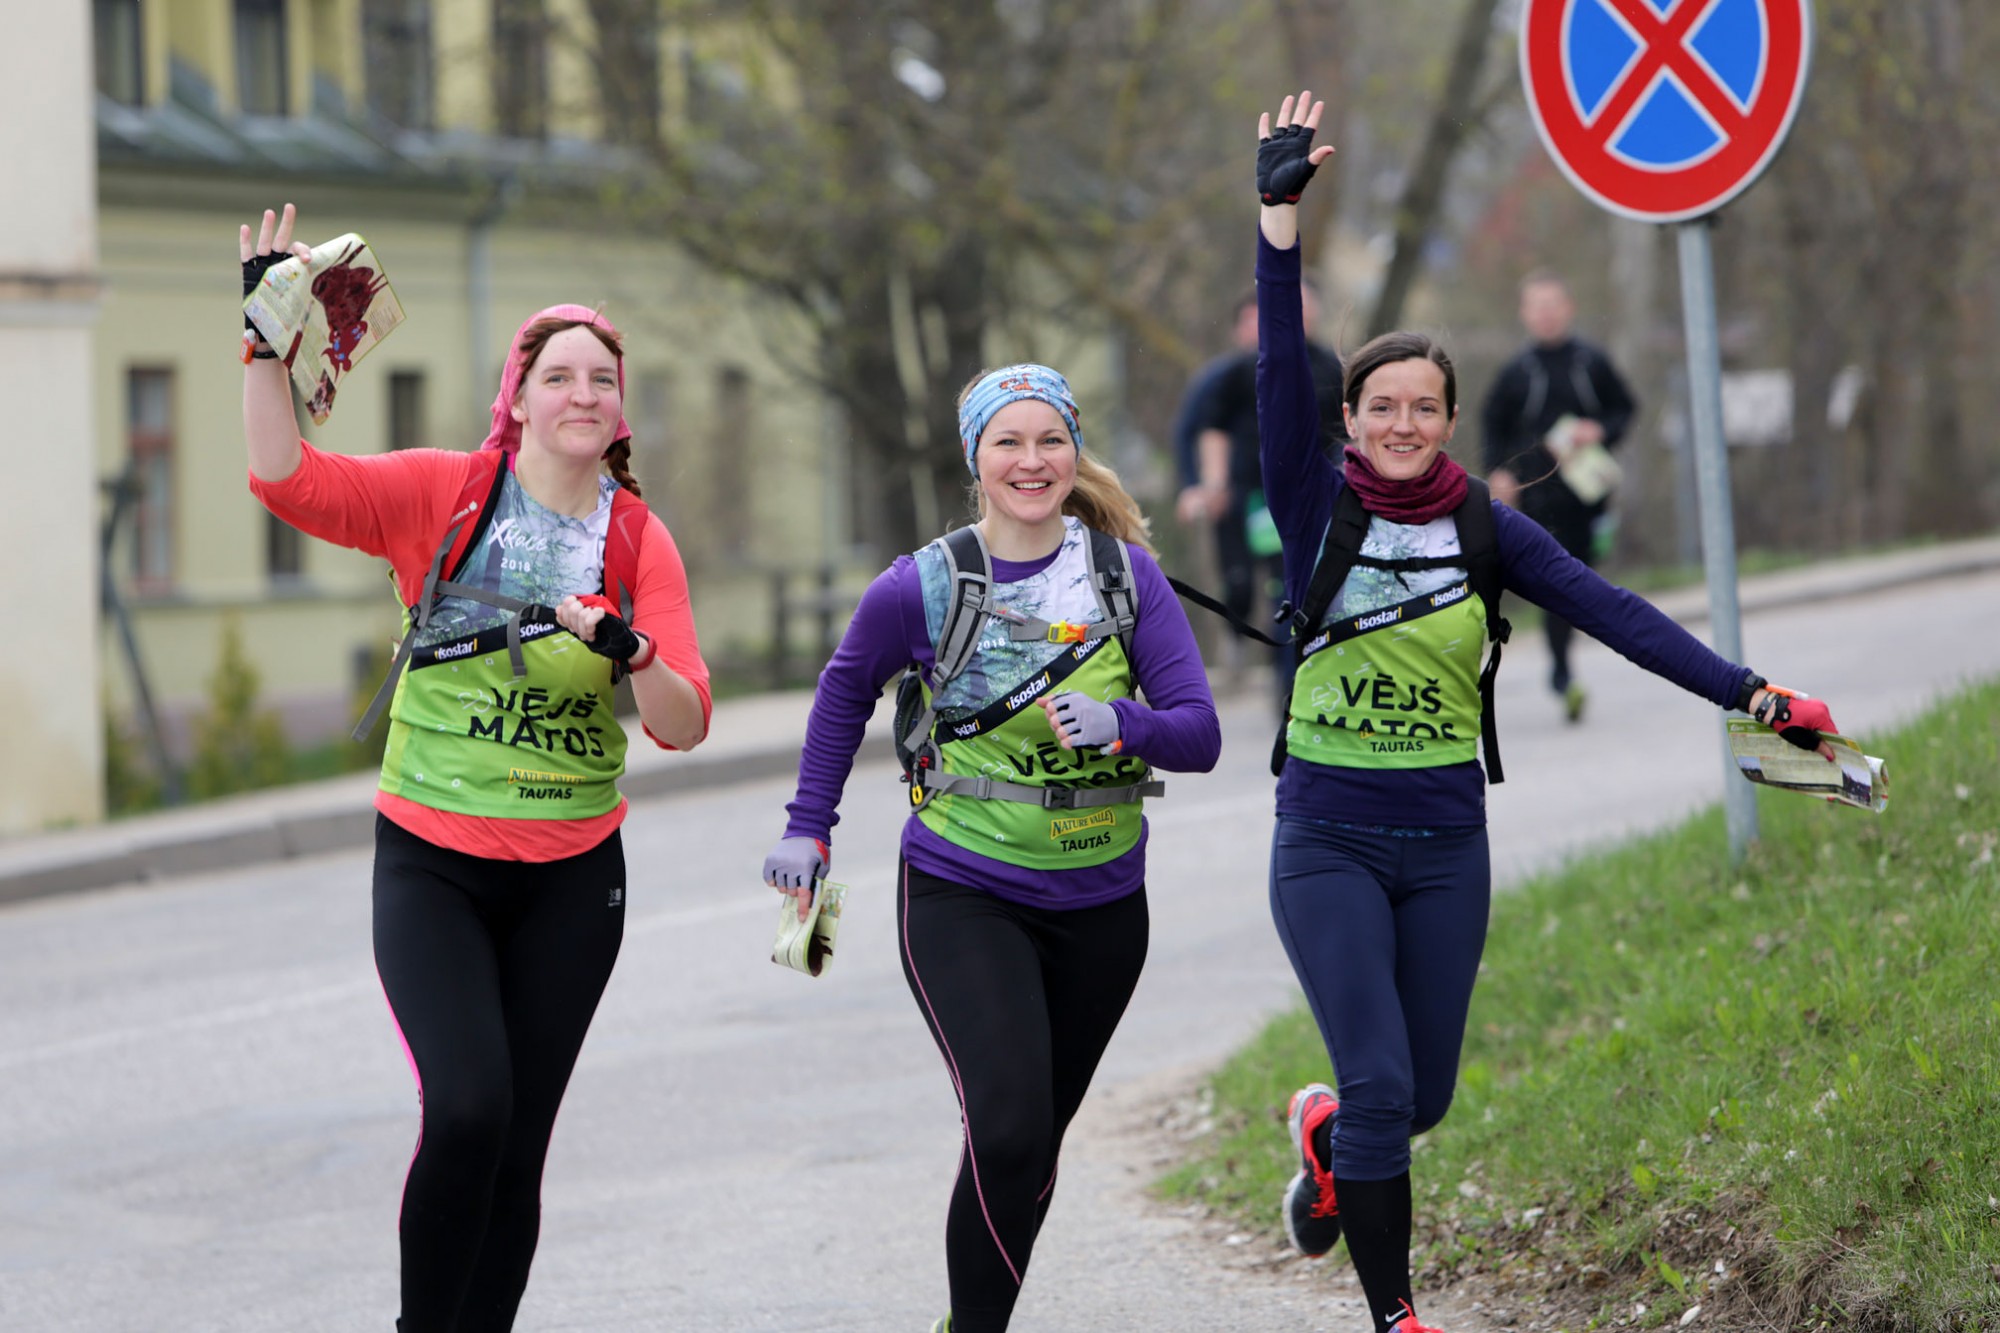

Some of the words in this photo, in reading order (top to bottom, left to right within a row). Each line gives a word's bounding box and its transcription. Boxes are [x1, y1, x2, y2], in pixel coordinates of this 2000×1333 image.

[501, 557, 531, 572] 2018
[1432, 584, 1467, 607] isostar
[1357, 607, 1400, 631] isostar
[436, 640, 476, 660] isostar
[1008, 673, 1049, 711] isostar
[1339, 672, 1442, 715] VĒJŠ
[489, 687, 599, 721] VĒJŠ
[468, 715, 605, 758] MATOS
[1370, 740, 1425, 753] TAUTAS
[518, 787, 573, 799] TAUTAS
[1052, 817, 1089, 838] NATURE
[1089, 809, 1114, 825] VALLEY
[1061, 831, 1111, 852] TAUTAS
